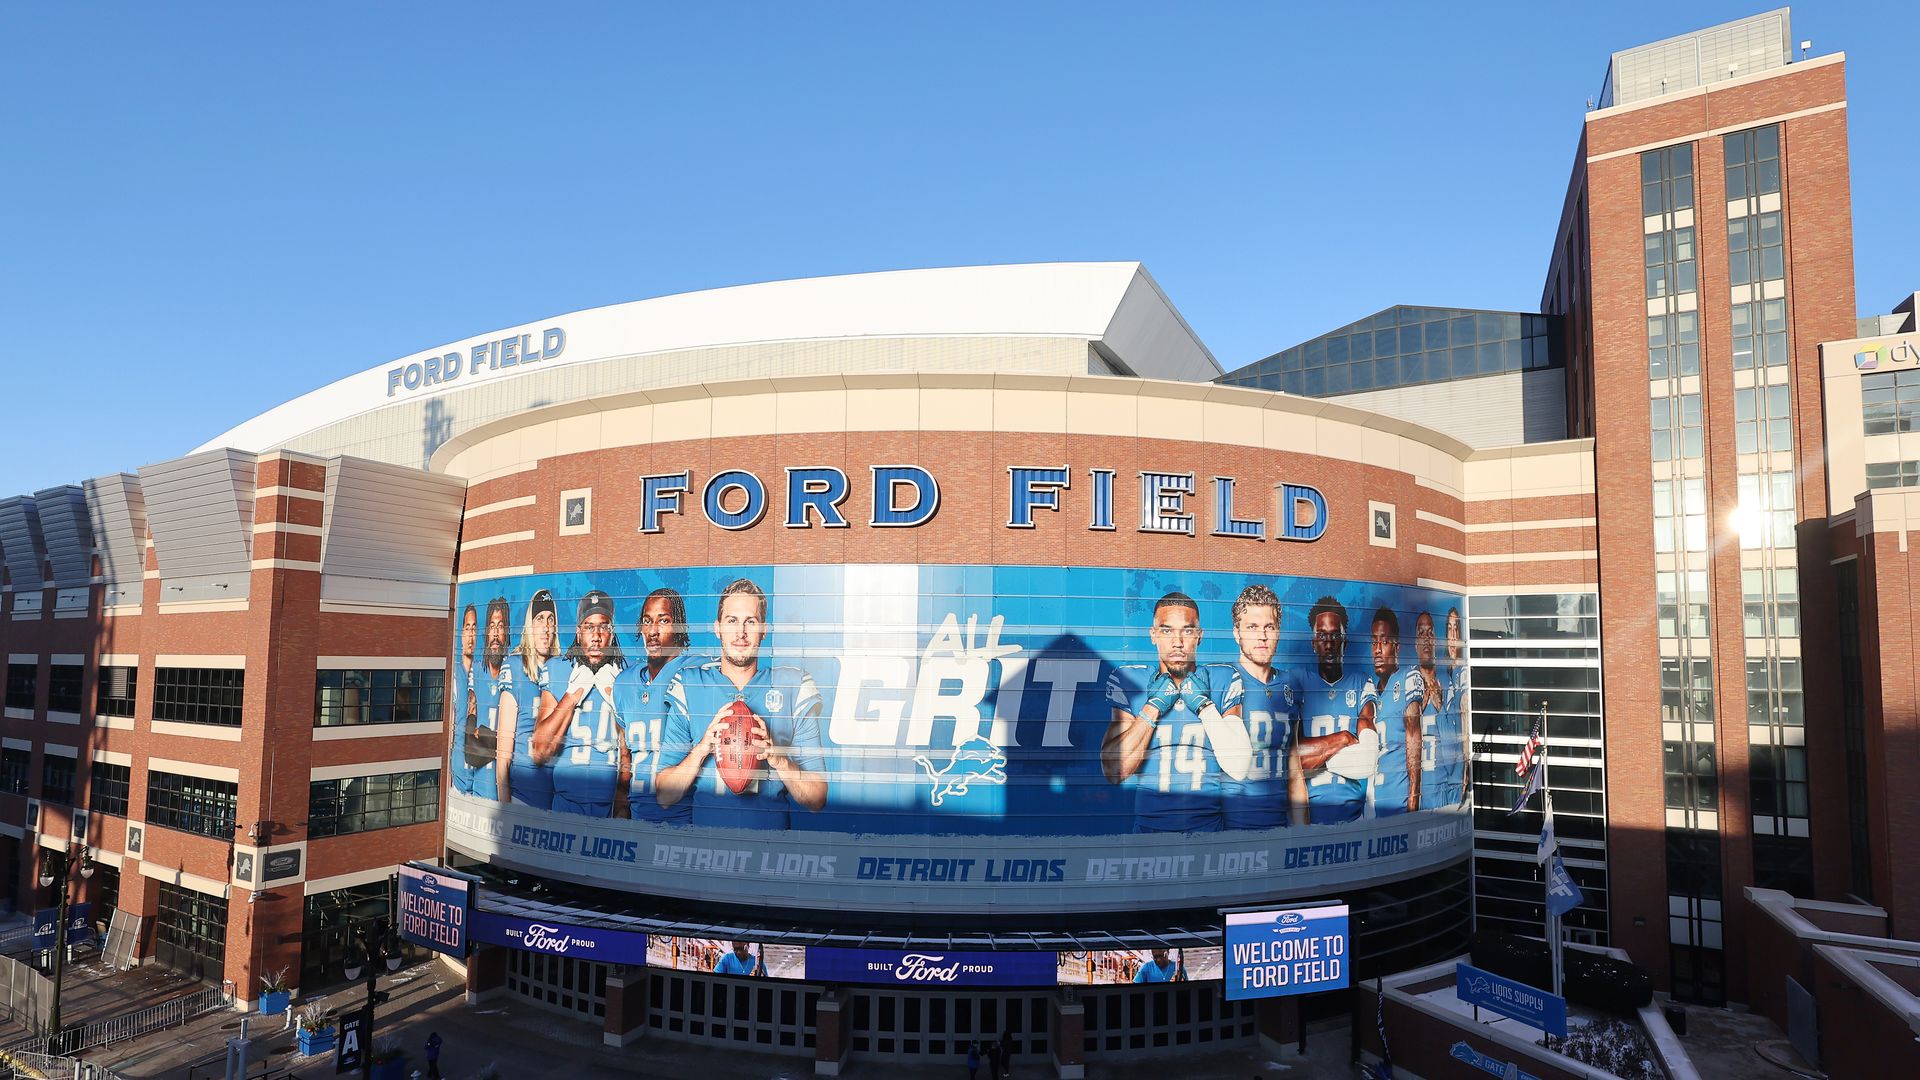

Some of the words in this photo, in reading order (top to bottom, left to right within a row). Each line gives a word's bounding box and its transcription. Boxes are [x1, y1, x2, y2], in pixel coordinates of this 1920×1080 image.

[386, 350, 463, 398] FORD
[469, 326, 567, 376] FIELD
[638, 463, 941, 533] FORD
[1005, 464, 1329, 542] FIELD
[922, 612, 1023, 665] ALL
[828, 656, 1101, 748] GRIT
[628, 718, 662, 794] 21
[1155, 721, 1207, 793] 14
[511, 824, 576, 853] DETROIT
[580, 837, 637, 863] LIONS
[1284, 840, 1362, 869] DETROIT
[1367, 834, 1408, 861] LIONS
[653, 844, 752, 873] DETROIT
[760, 853, 838, 879] LIONS
[857, 857, 975, 881] DETROIT
[984, 859, 1066, 882] LIONS
[1086, 853, 1194, 881] DETROIT
[1203, 850, 1269, 877] LIONS
[400, 890, 446, 922] WELCOME
[448, 904, 463, 926] TO
[403, 912, 427, 937] FORD
[429, 921, 459, 947] FIELD
[505, 928, 523, 938] BUILT
[523, 923, 570, 953] Ford
[571, 938, 595, 948] PROUD
[1232, 937, 1320, 965] WELCOME
[1323, 934, 1344, 957] TO
[867, 962, 894, 971] BUILT
[895, 953, 960, 982] Ford
[962, 965, 994, 973] PROUD
[1242, 964, 1289, 989] FORD
[1293, 958, 1340, 984] FIELD
[1491, 981, 1513, 1000] LIONS
[1514, 990, 1544, 1011] SUPPLY
[341, 1029, 359, 1056] A
[343, 1019, 360, 1031] GATE
[1484, 1059, 1505, 1077] GATE
